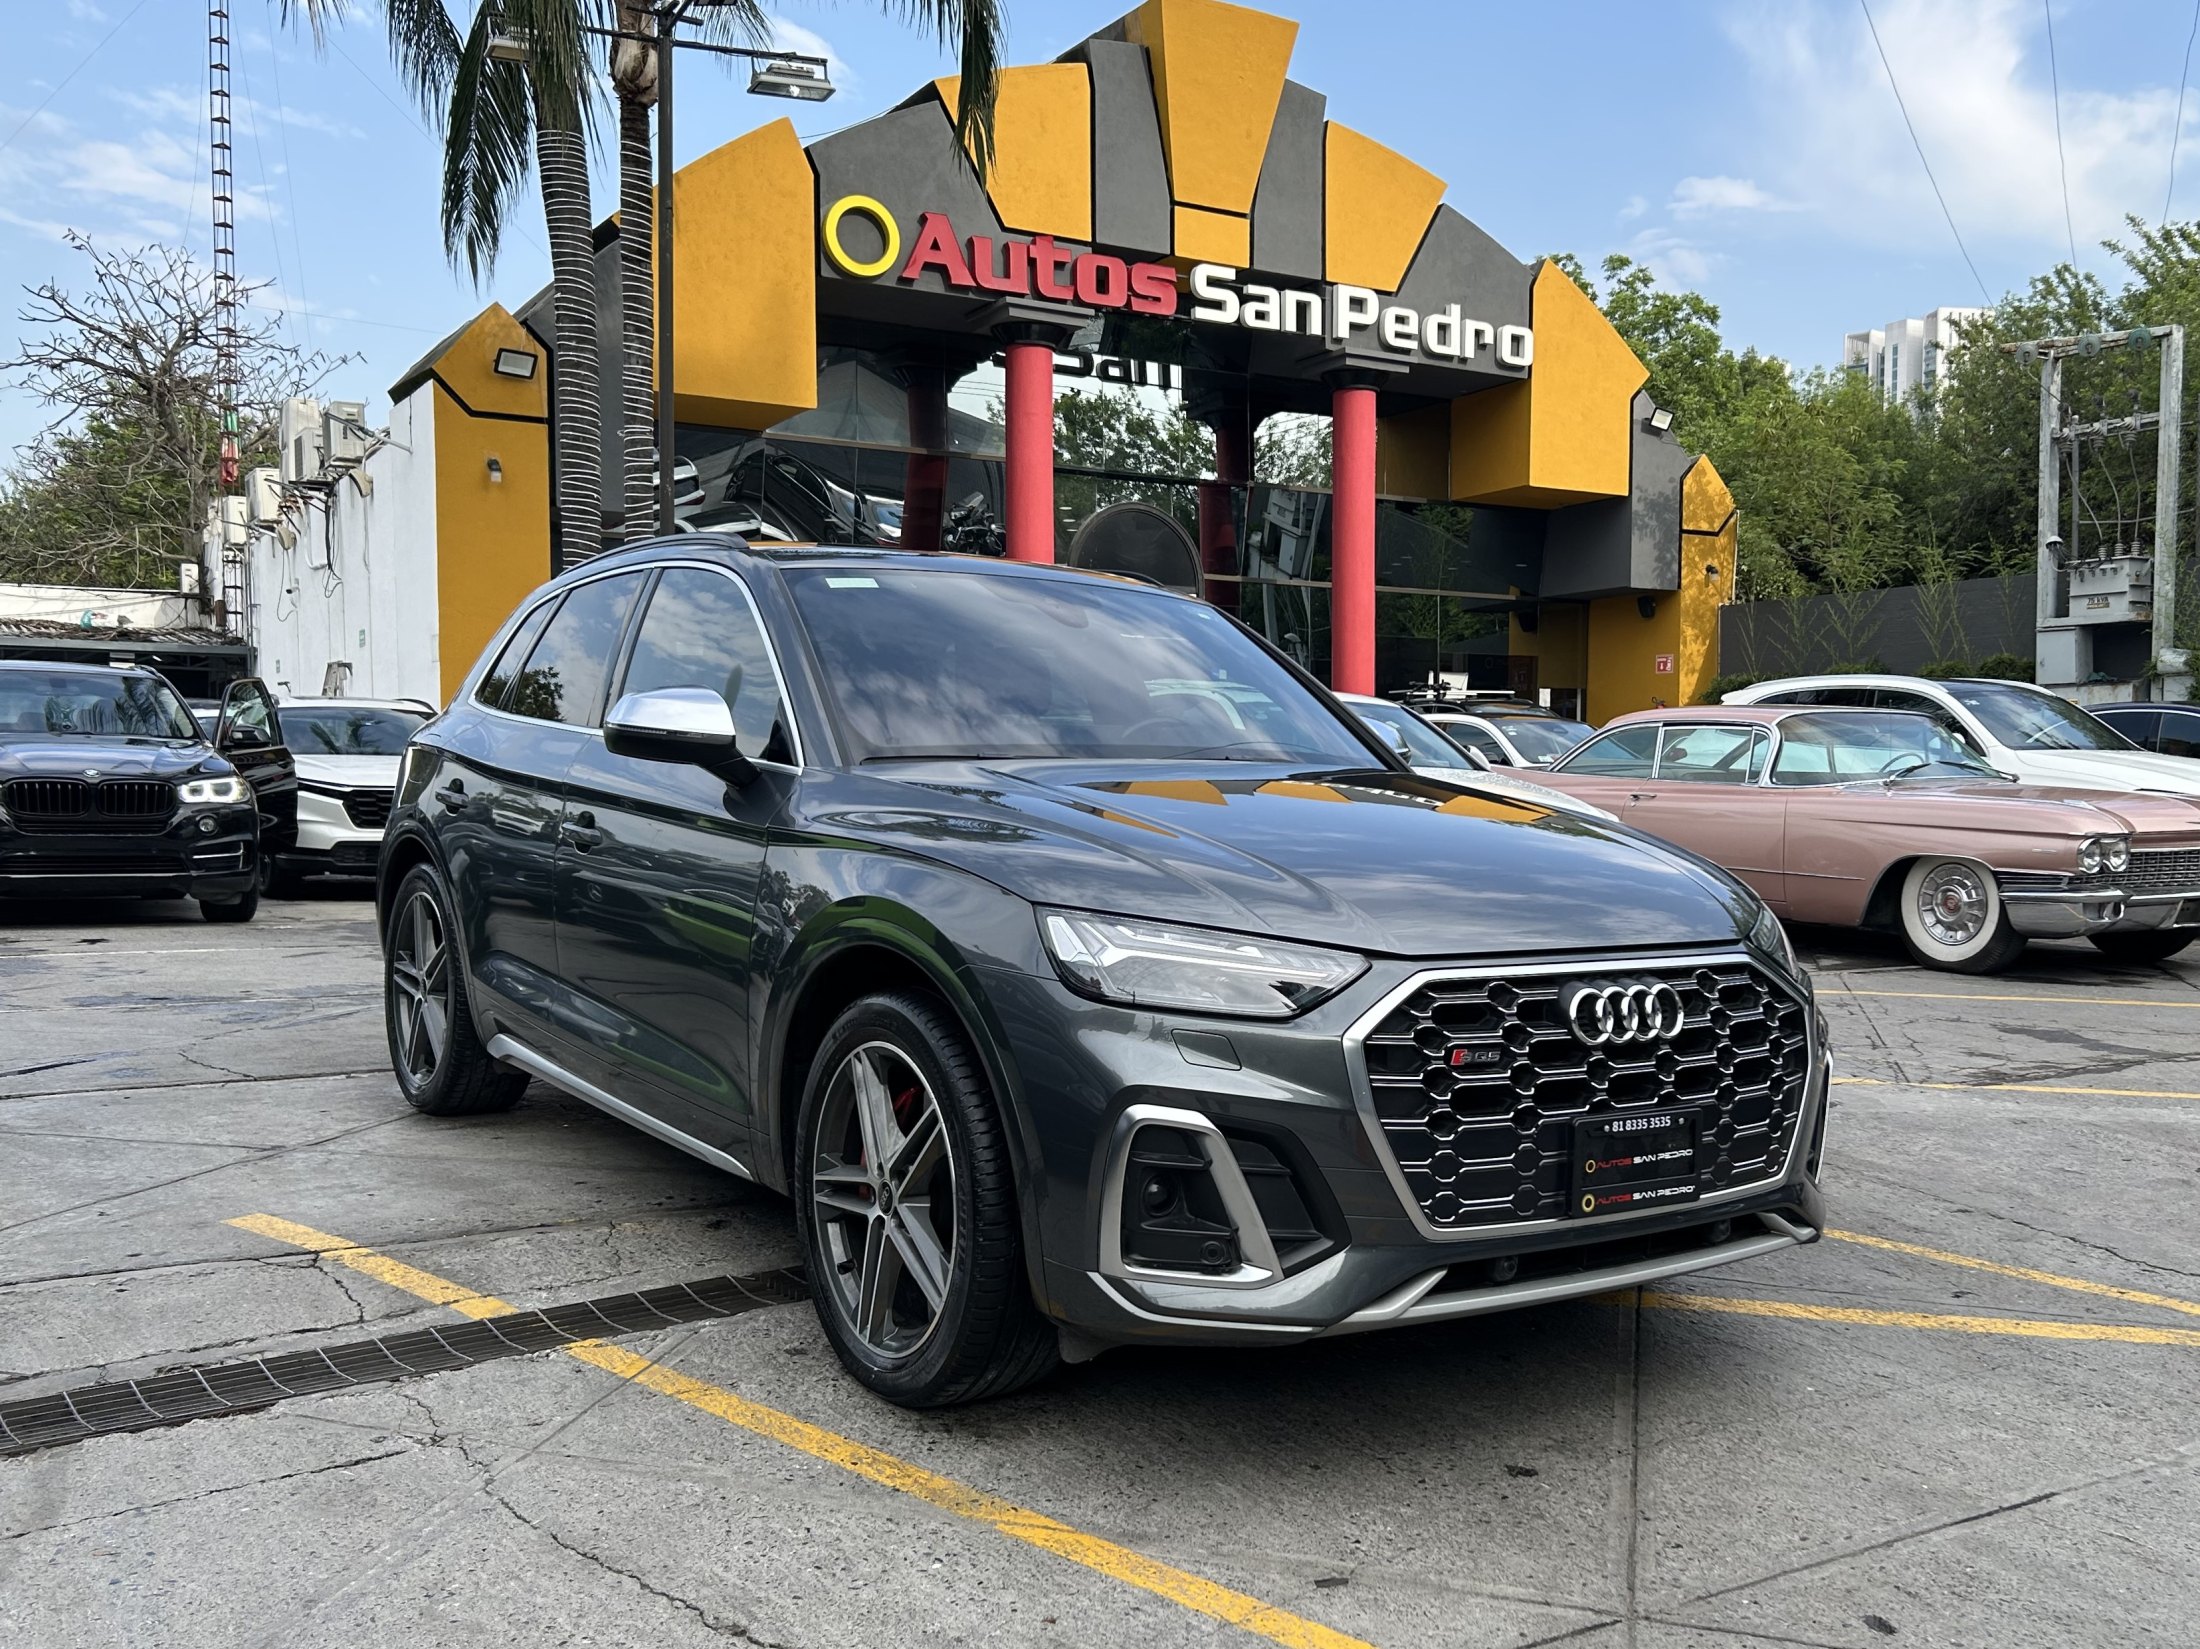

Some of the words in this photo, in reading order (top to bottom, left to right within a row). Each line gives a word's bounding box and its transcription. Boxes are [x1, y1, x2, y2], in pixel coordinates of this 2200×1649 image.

[901, 211, 1177, 316] Autos
[1612, 1121, 1623, 1132] 81
[1625, 1119, 1648, 1131] 8335
[1649, 1116, 1671, 1128] 3535
[1596, 1158, 1632, 1168] AUTOS
[1633, 1154, 1656, 1164] SAN
[1657, 1149, 1693, 1160] PEDRO
[1596, 1194, 1632, 1205] AUTOS
[1633, 1190, 1656, 1200] SAN
